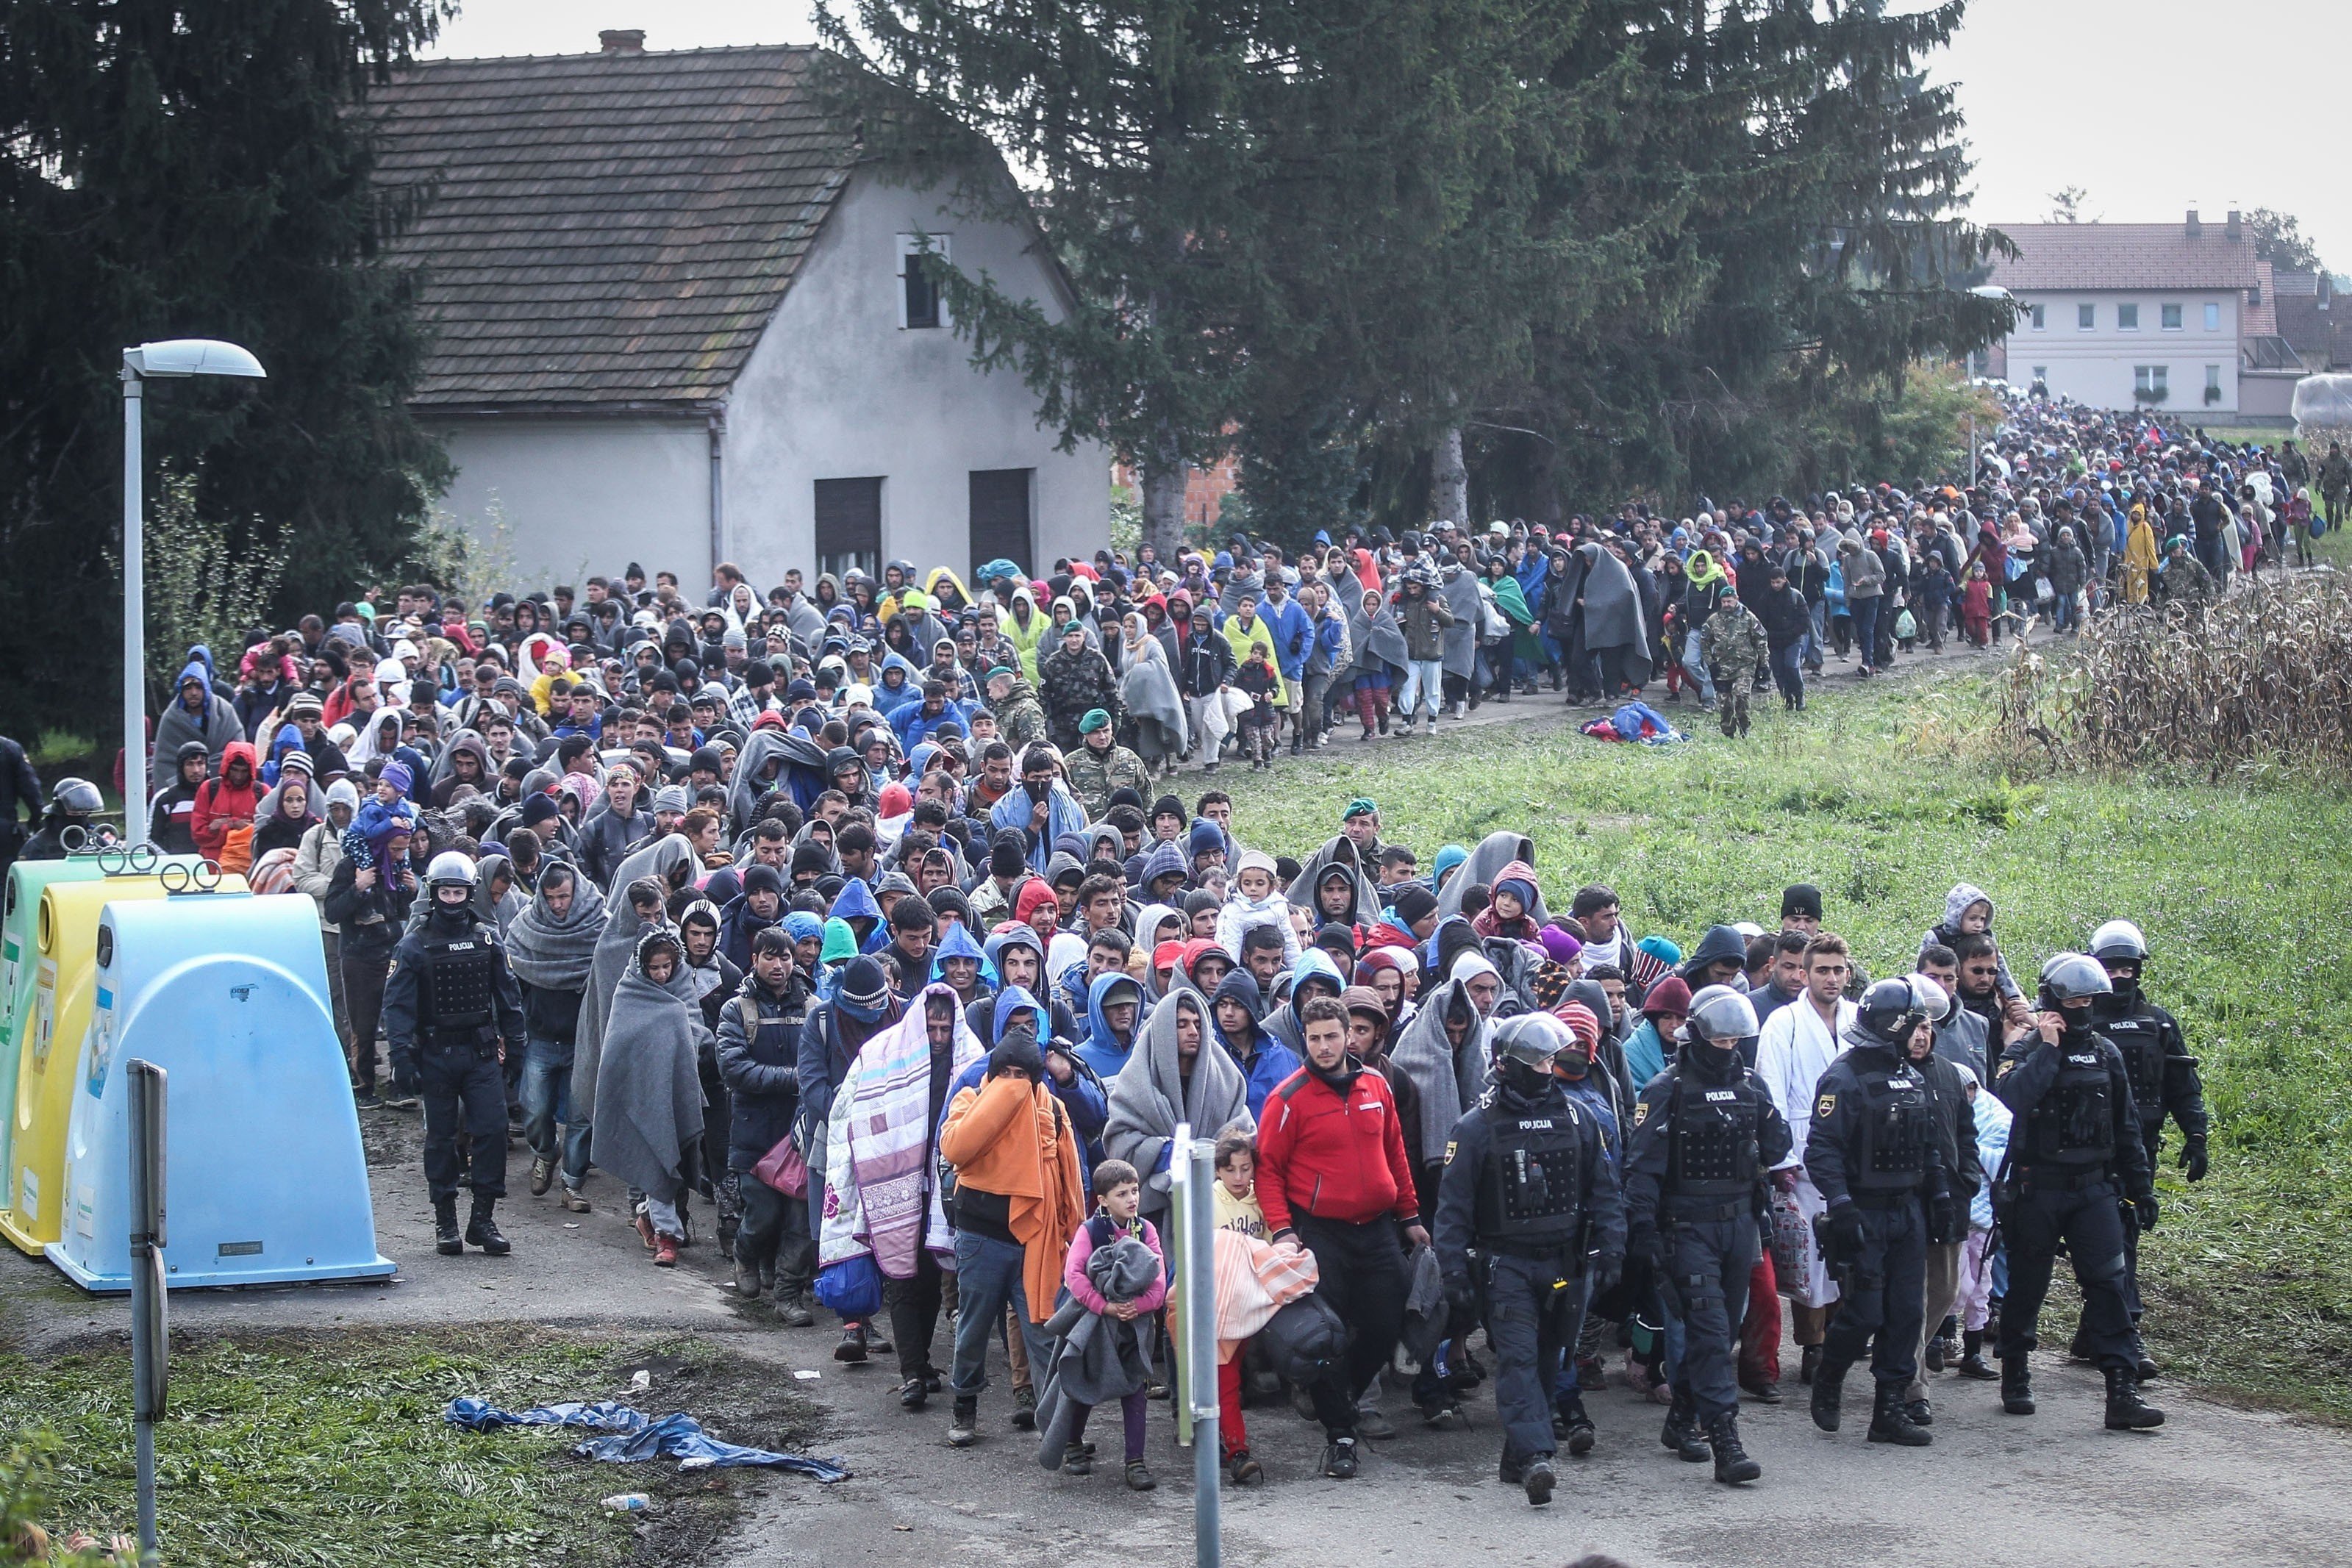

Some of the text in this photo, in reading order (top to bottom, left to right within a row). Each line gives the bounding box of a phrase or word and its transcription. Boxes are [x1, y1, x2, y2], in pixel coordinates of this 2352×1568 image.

[448, 942, 475, 951] POLICIJA
[2109, 1021, 2140, 1030] POLICIJA
[1887, 1079, 1913, 1089] POLICIJA
[1706, 1091, 1737, 1102] POLICIJA
[1518, 1120, 1553, 1130] POLICIJA
